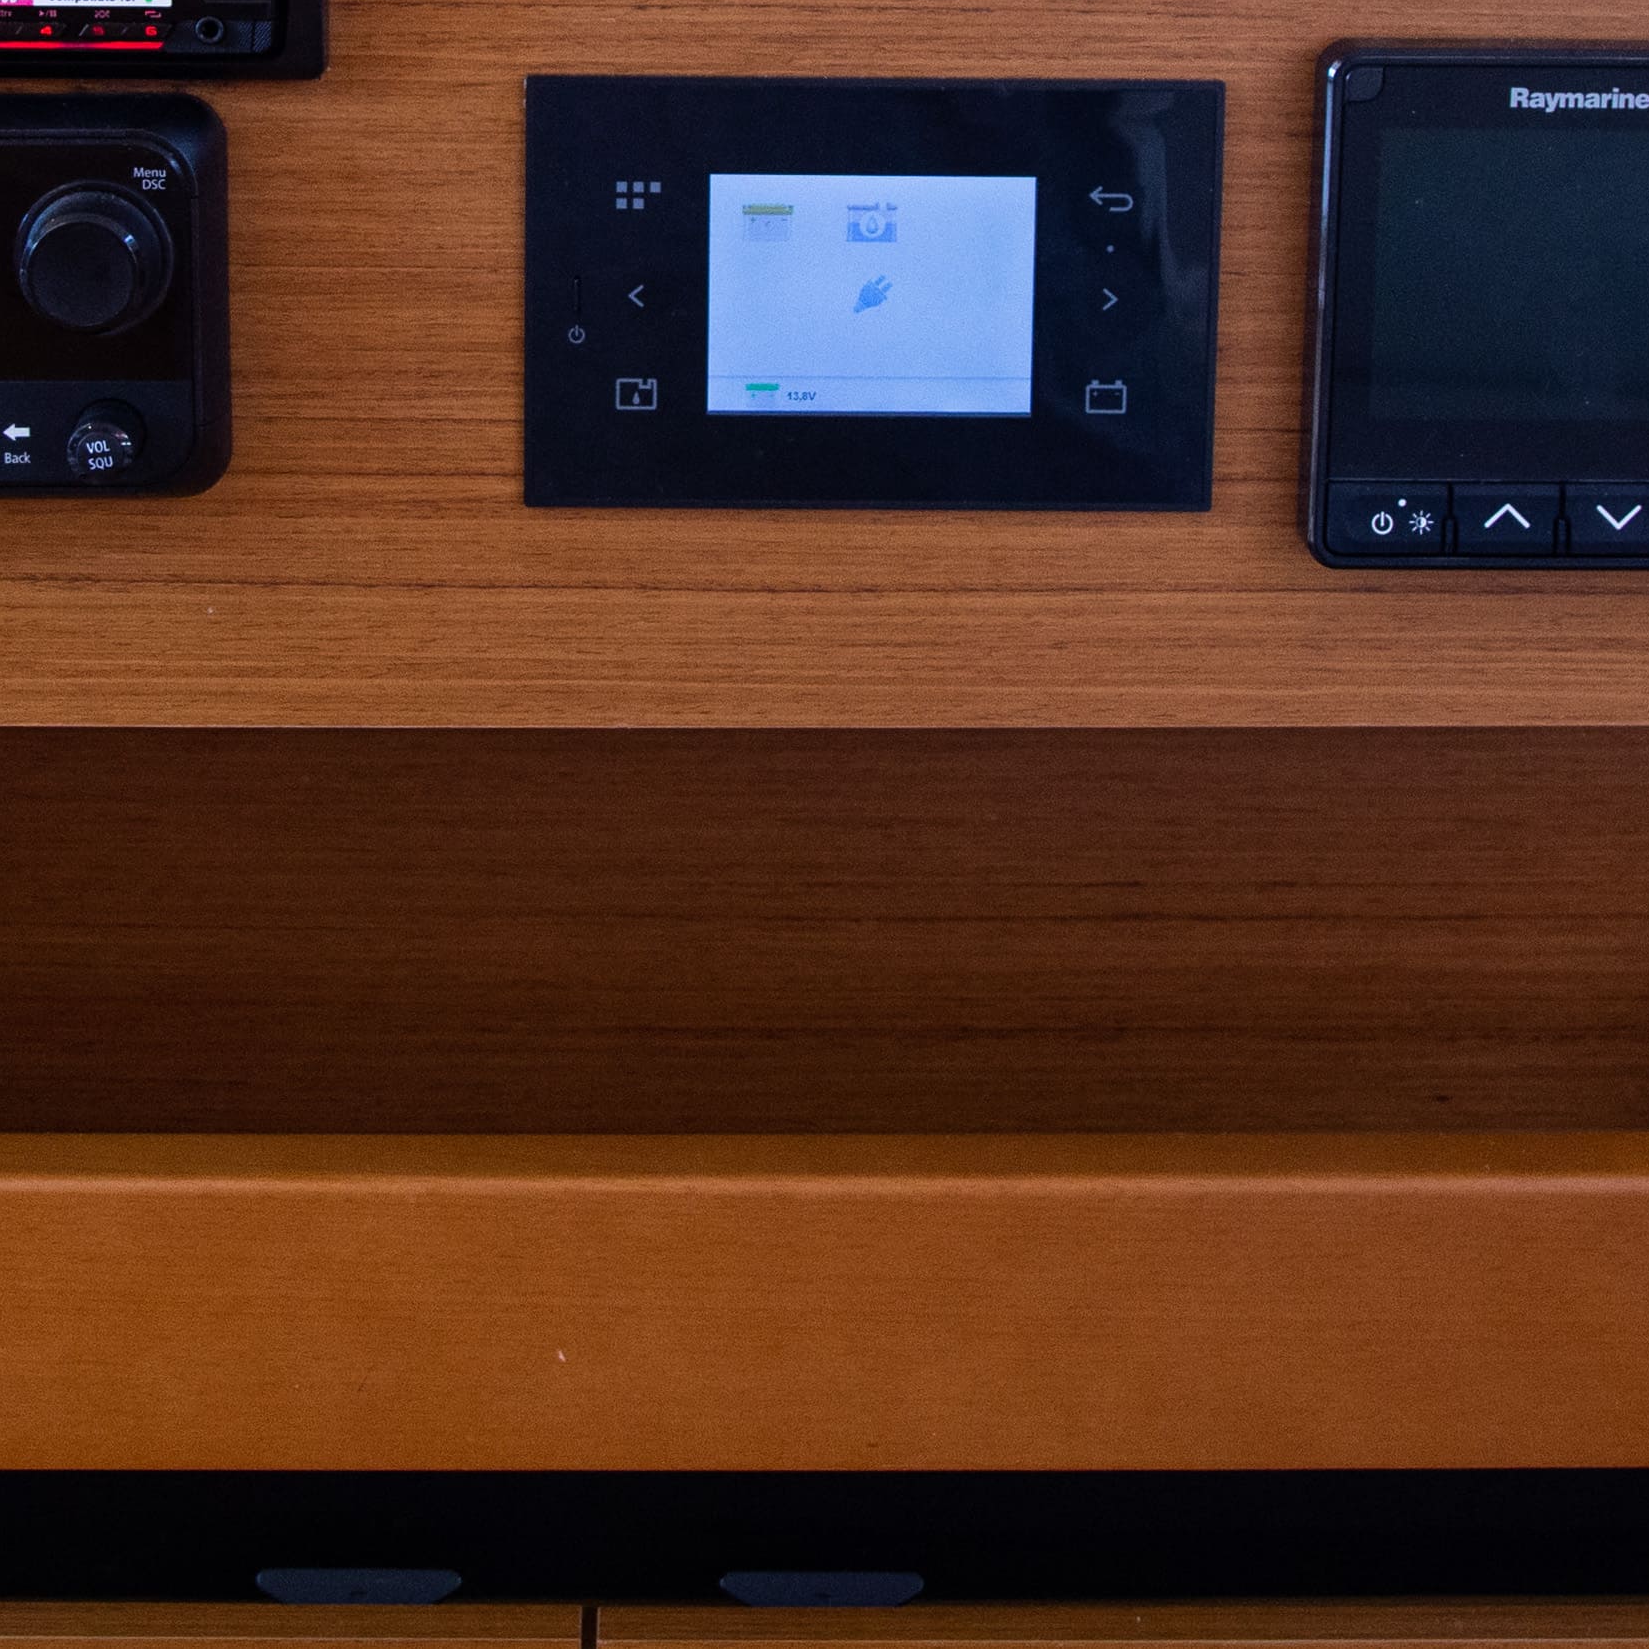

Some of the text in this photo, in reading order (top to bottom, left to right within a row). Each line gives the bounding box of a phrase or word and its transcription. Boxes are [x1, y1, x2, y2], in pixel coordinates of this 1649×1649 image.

[133, 168, 166, 178] Menu
[142, 179, 166, 190] DSC
[87, 441, 110, 454] VOL
[4, 452, 31, 464] Back
[88, 456, 113, 471] SQU
